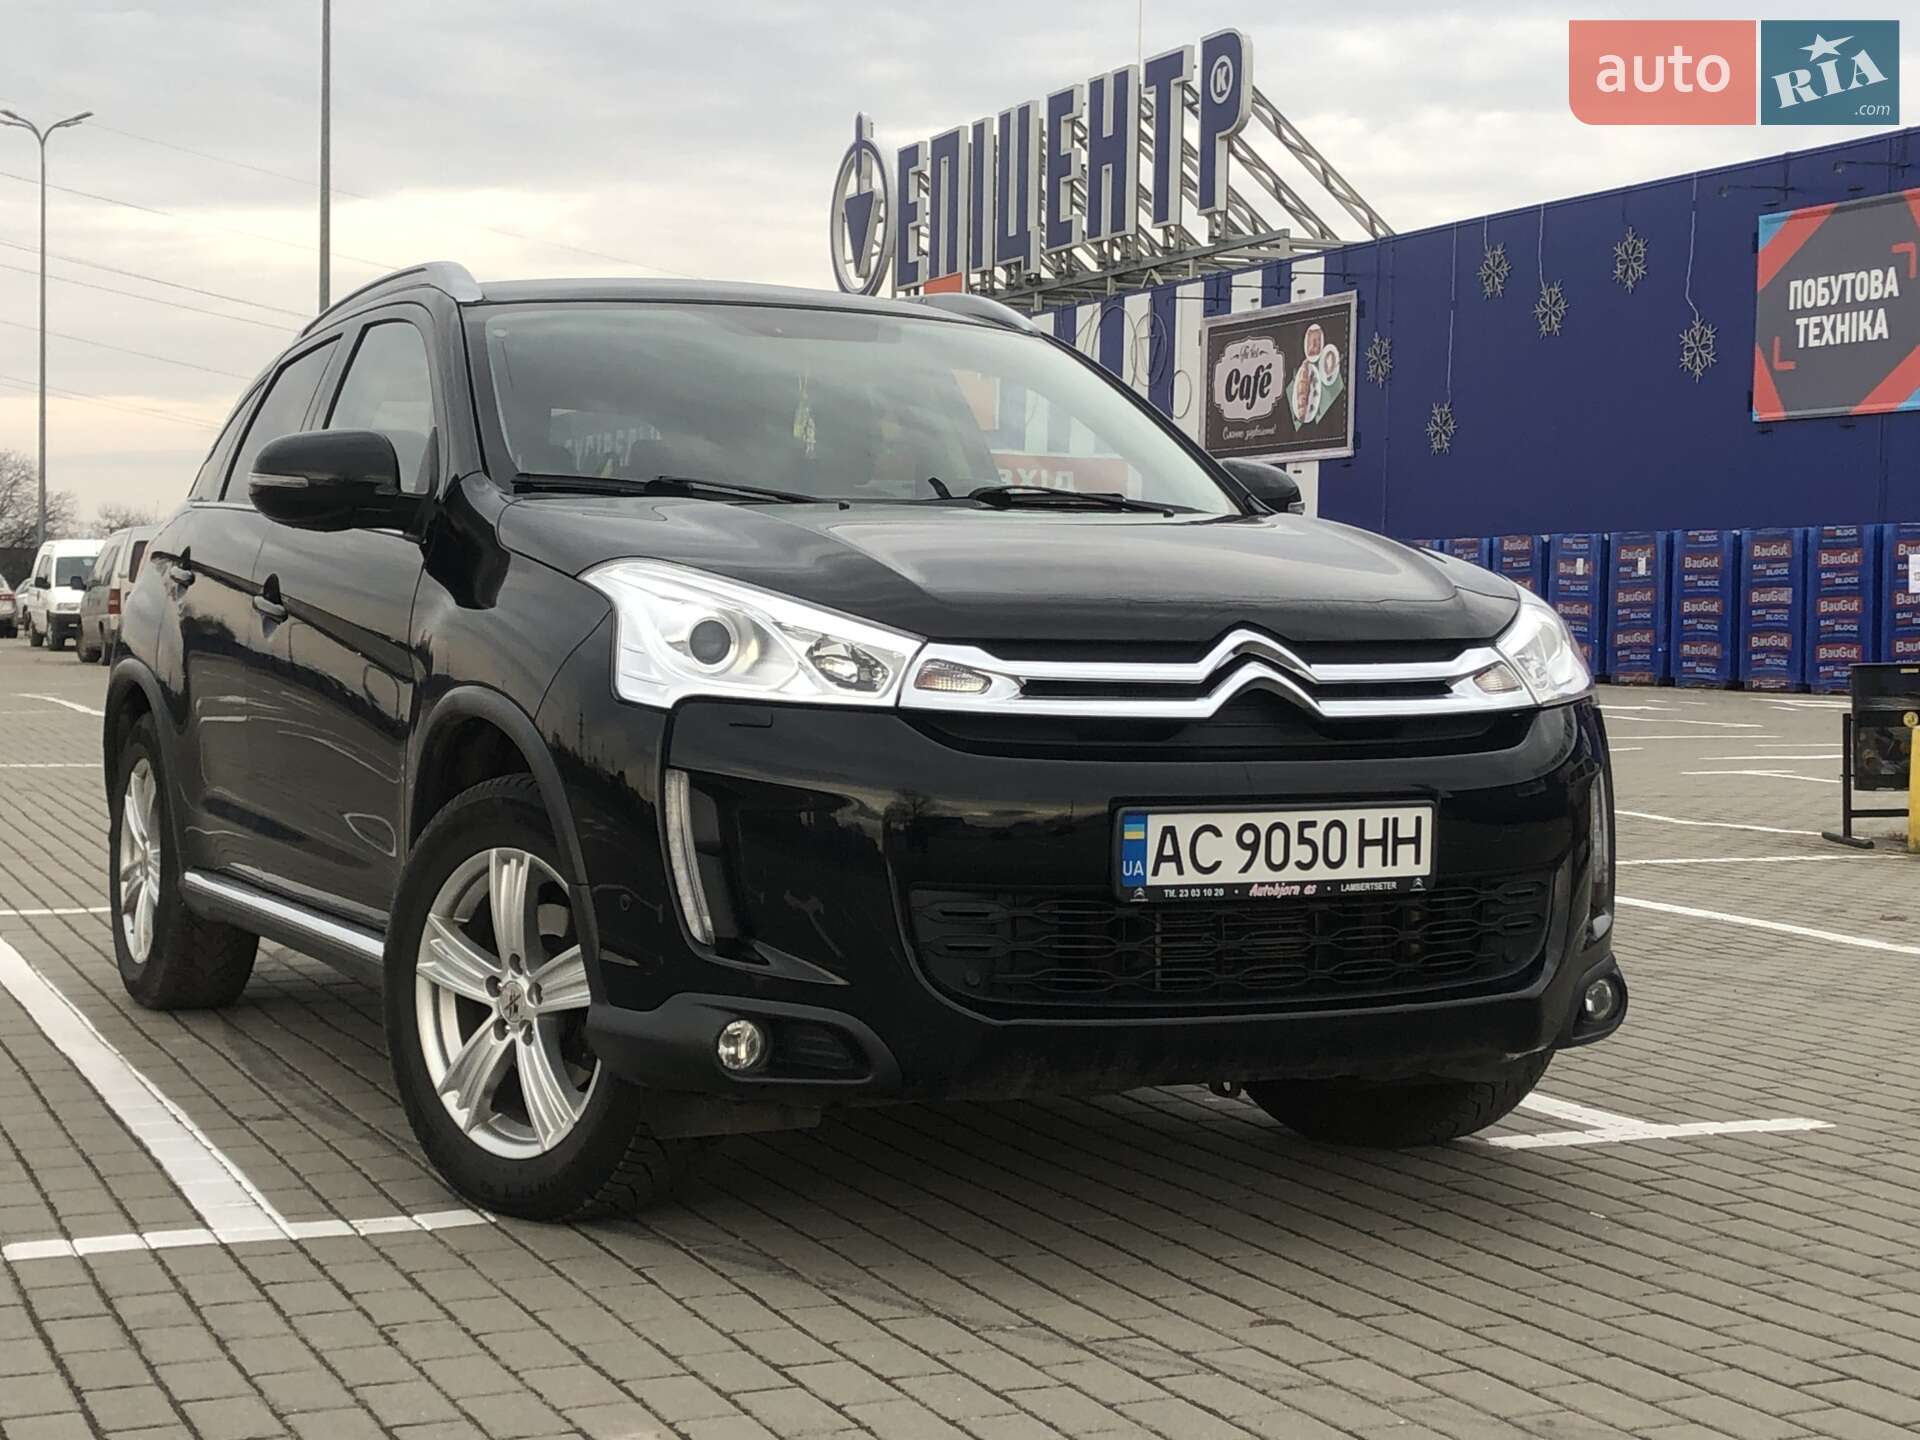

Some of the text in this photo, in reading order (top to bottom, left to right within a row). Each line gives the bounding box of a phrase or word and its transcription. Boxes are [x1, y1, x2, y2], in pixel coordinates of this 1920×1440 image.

[897, 28, 1252, 288] ЕПІЦЕНТР
[1789, 266, 1900, 311] ПОБУТОВА
[1796, 307, 1889, 349] ТЕХНІКА
[1225, 363, 1272, 410] Café
[1754, 544, 1788, 557] BauGut
[1684, 556, 1719, 569] BauGut
[1820, 552, 1858, 565] BauGut
[1617, 591, 1651, 603] BauGut
[1683, 601, 1718, 613] BauGut
[1820, 599, 1858, 613] BauGut
[1751, 635, 1788, 648] BauGut
[1819, 646, 1858, 659] BauGut
[1151, 815, 1422, 877] AC 9050 HH
[1123, 860, 1144, 876] UA
[1203, 888, 1213, 897] 10
[1214, 888, 1225, 896] 20
[1303, 884, 1317, 895] as
[1340, 881, 1397, 893] LAMBERTSETER
